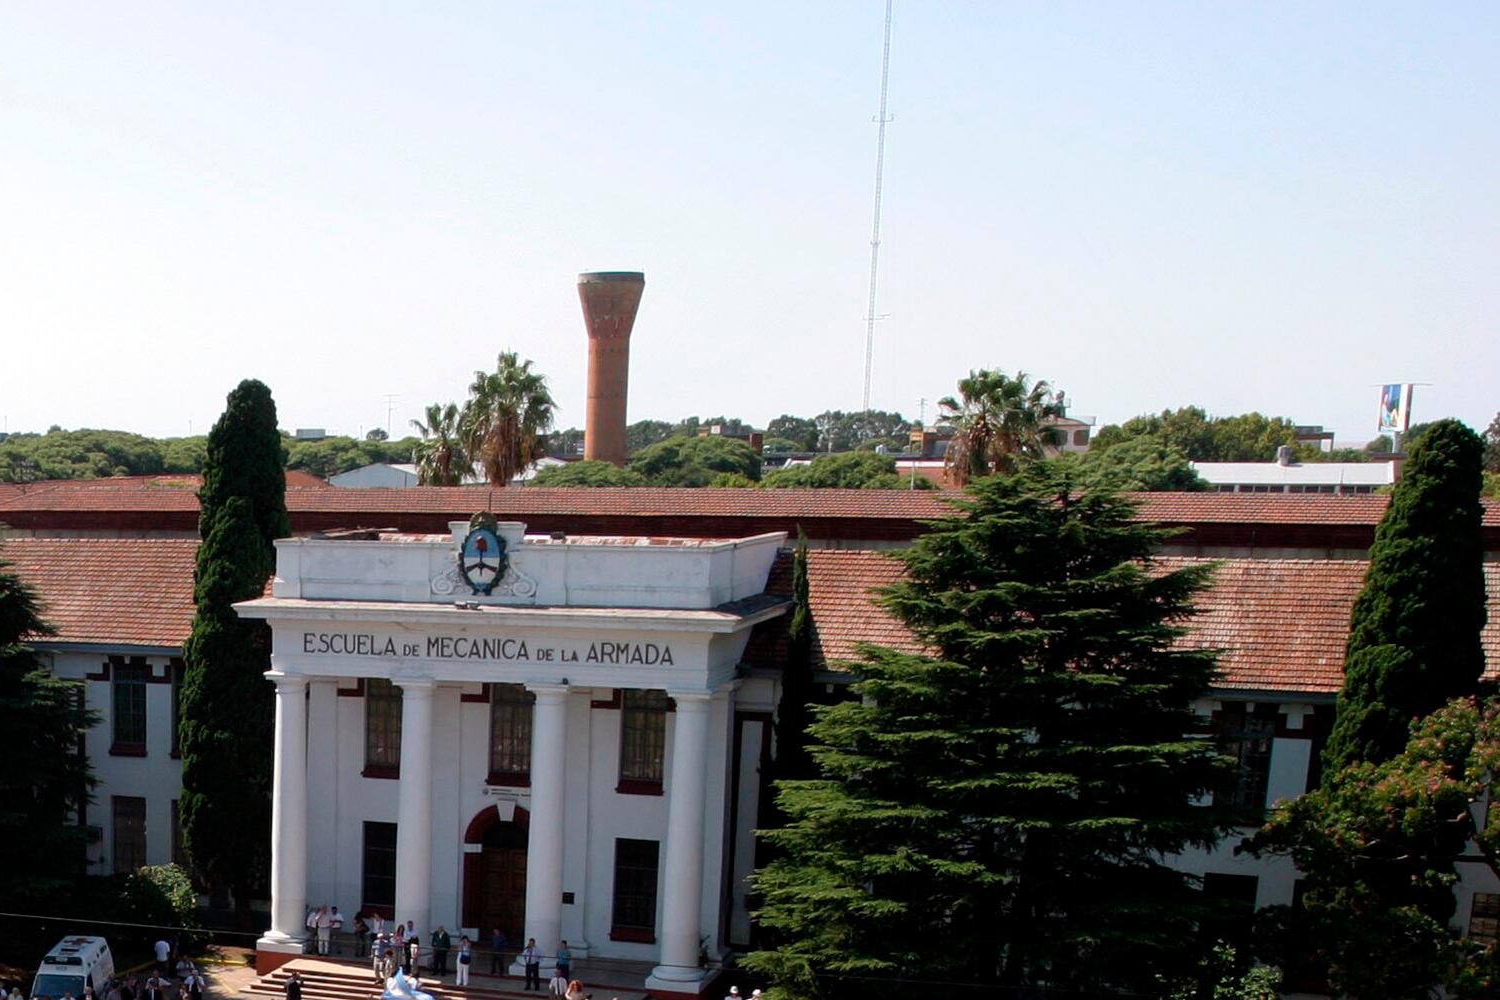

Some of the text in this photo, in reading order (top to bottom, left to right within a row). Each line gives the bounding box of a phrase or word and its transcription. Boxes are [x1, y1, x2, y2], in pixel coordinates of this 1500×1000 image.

[303, 633, 674, 666] ESCUELA DE MECANICA DE LA ARMADA
